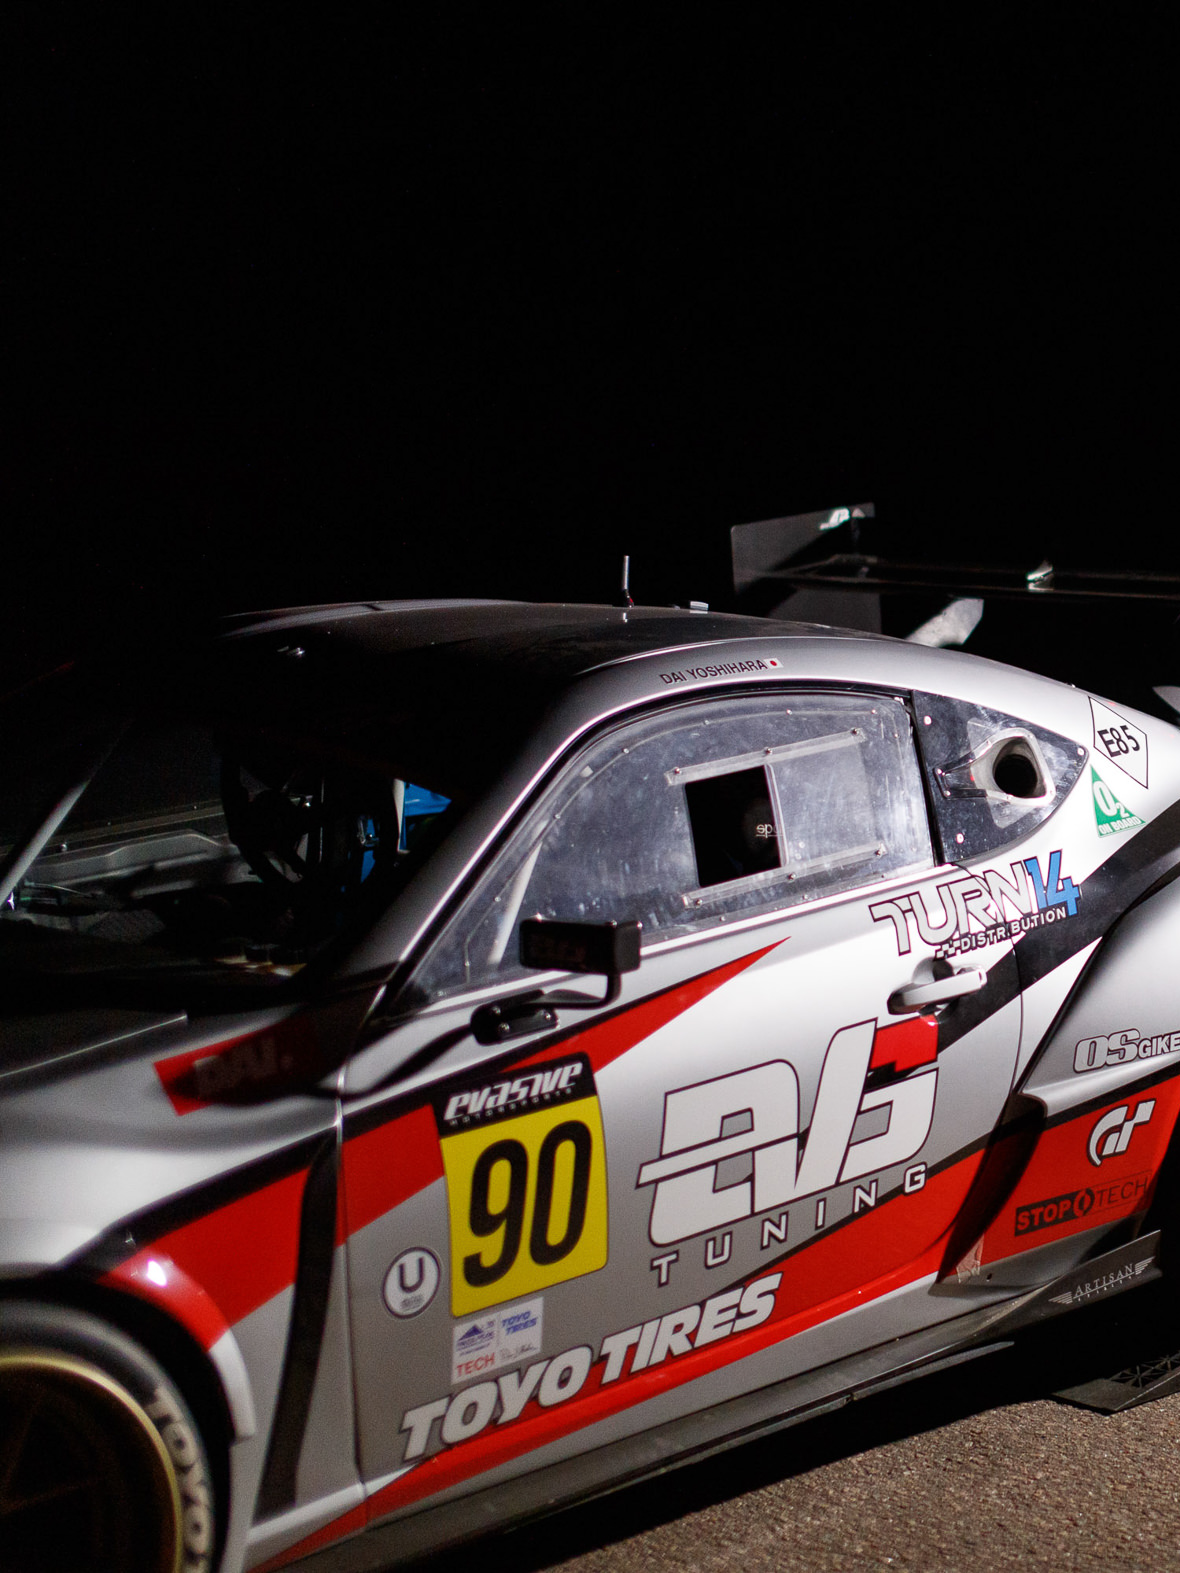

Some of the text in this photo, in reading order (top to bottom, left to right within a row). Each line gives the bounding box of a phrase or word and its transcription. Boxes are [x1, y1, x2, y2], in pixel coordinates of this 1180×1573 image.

[660, 659, 767, 684] DAI YOSHIHARA
[1097, 725, 1140, 757] E85
[1098, 817, 1142, 835] ON BOARD
[959, 906, 1067, 953] DISTRIBUTION
[1073, 1028, 1141, 1074] OS
[463, 1120, 593, 1288] 90
[650, 1161, 928, 1288] TUNING
[1074, 1263, 1134, 1298] ARTISAN
[502, 1310, 531, 1328] TOYO
[505, 1317, 540, 1336] TIRES
[400, 1271, 785, 1462] TOYO TIRES
[457, 1352, 495, 1377] TECH
